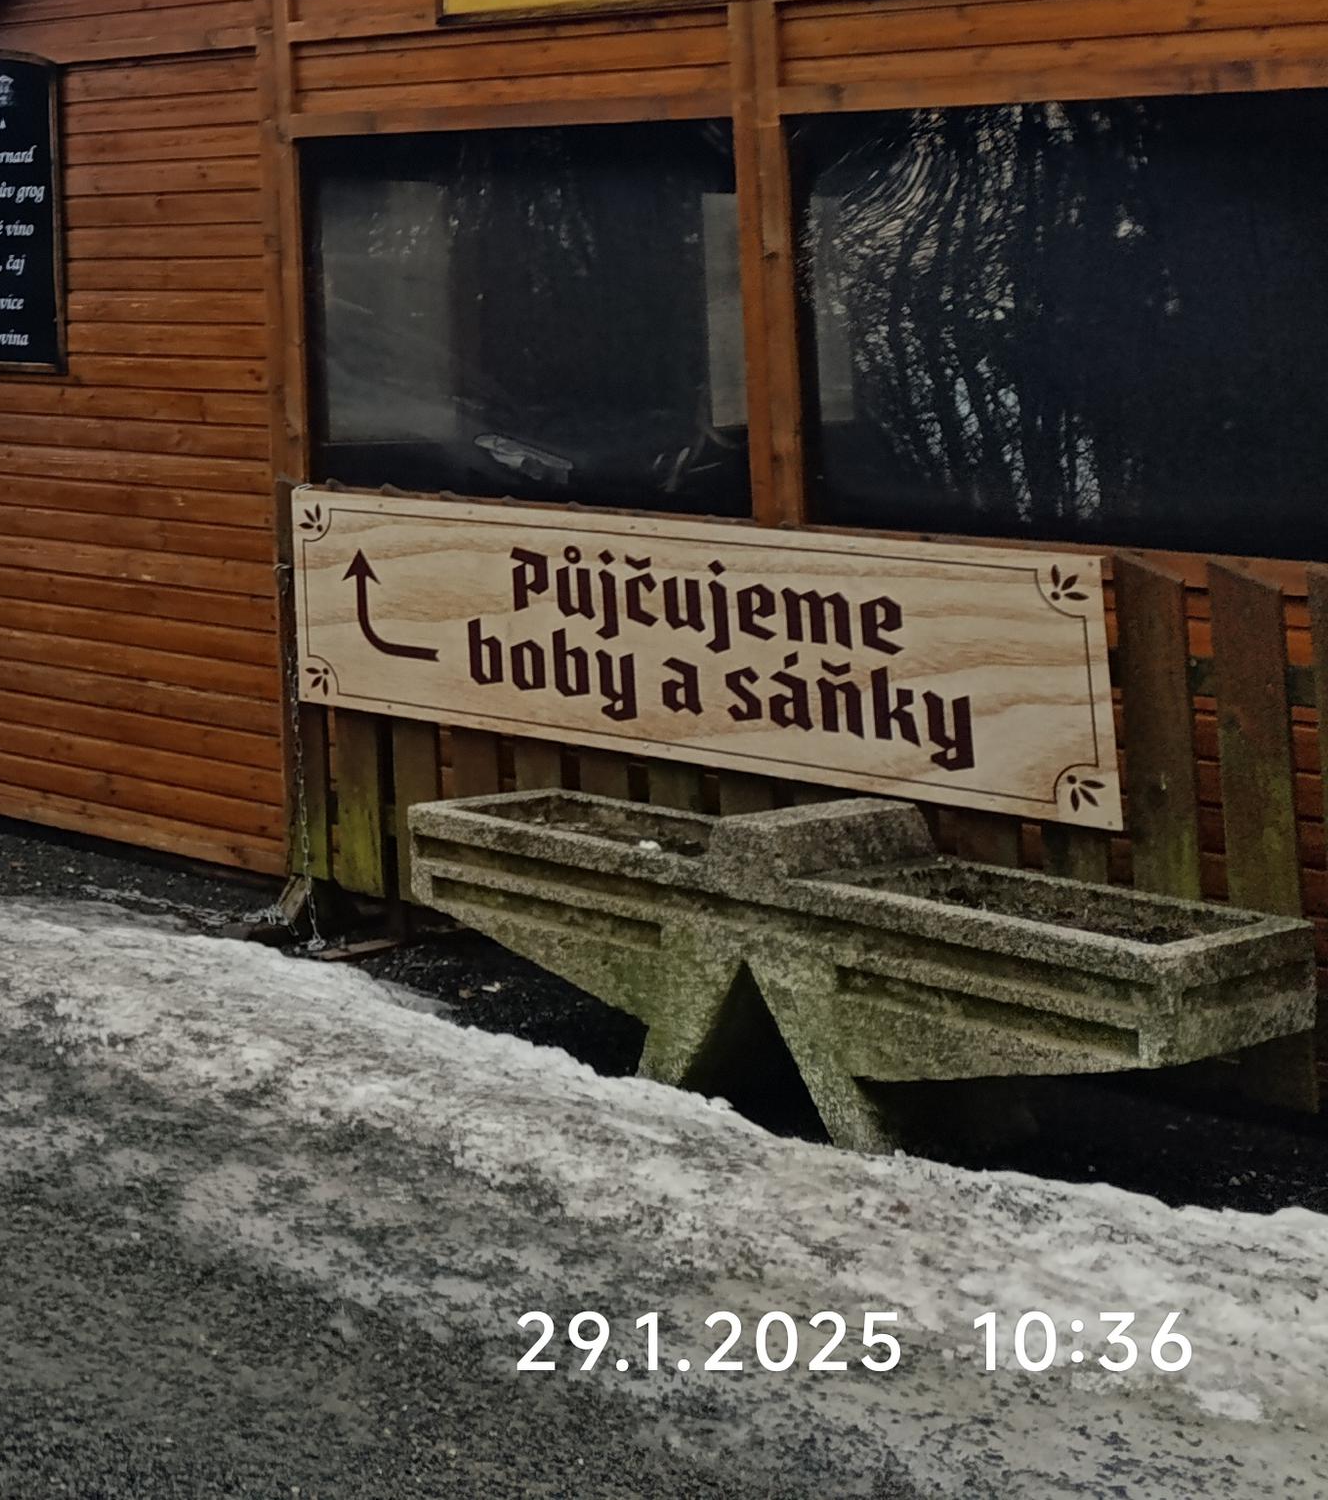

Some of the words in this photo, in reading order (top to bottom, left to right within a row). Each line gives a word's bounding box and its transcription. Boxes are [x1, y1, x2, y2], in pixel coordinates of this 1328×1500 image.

[15, 185, 45, 204] grog
[5, 220, 34, 237] víno
[5, 254, 25, 276] čaj
[510, 545, 904, 656] Půjčujeme
[467, 617, 640, 722] boby
[660, 656, 705, 715] a
[723, 652, 977, 772] sáňky
